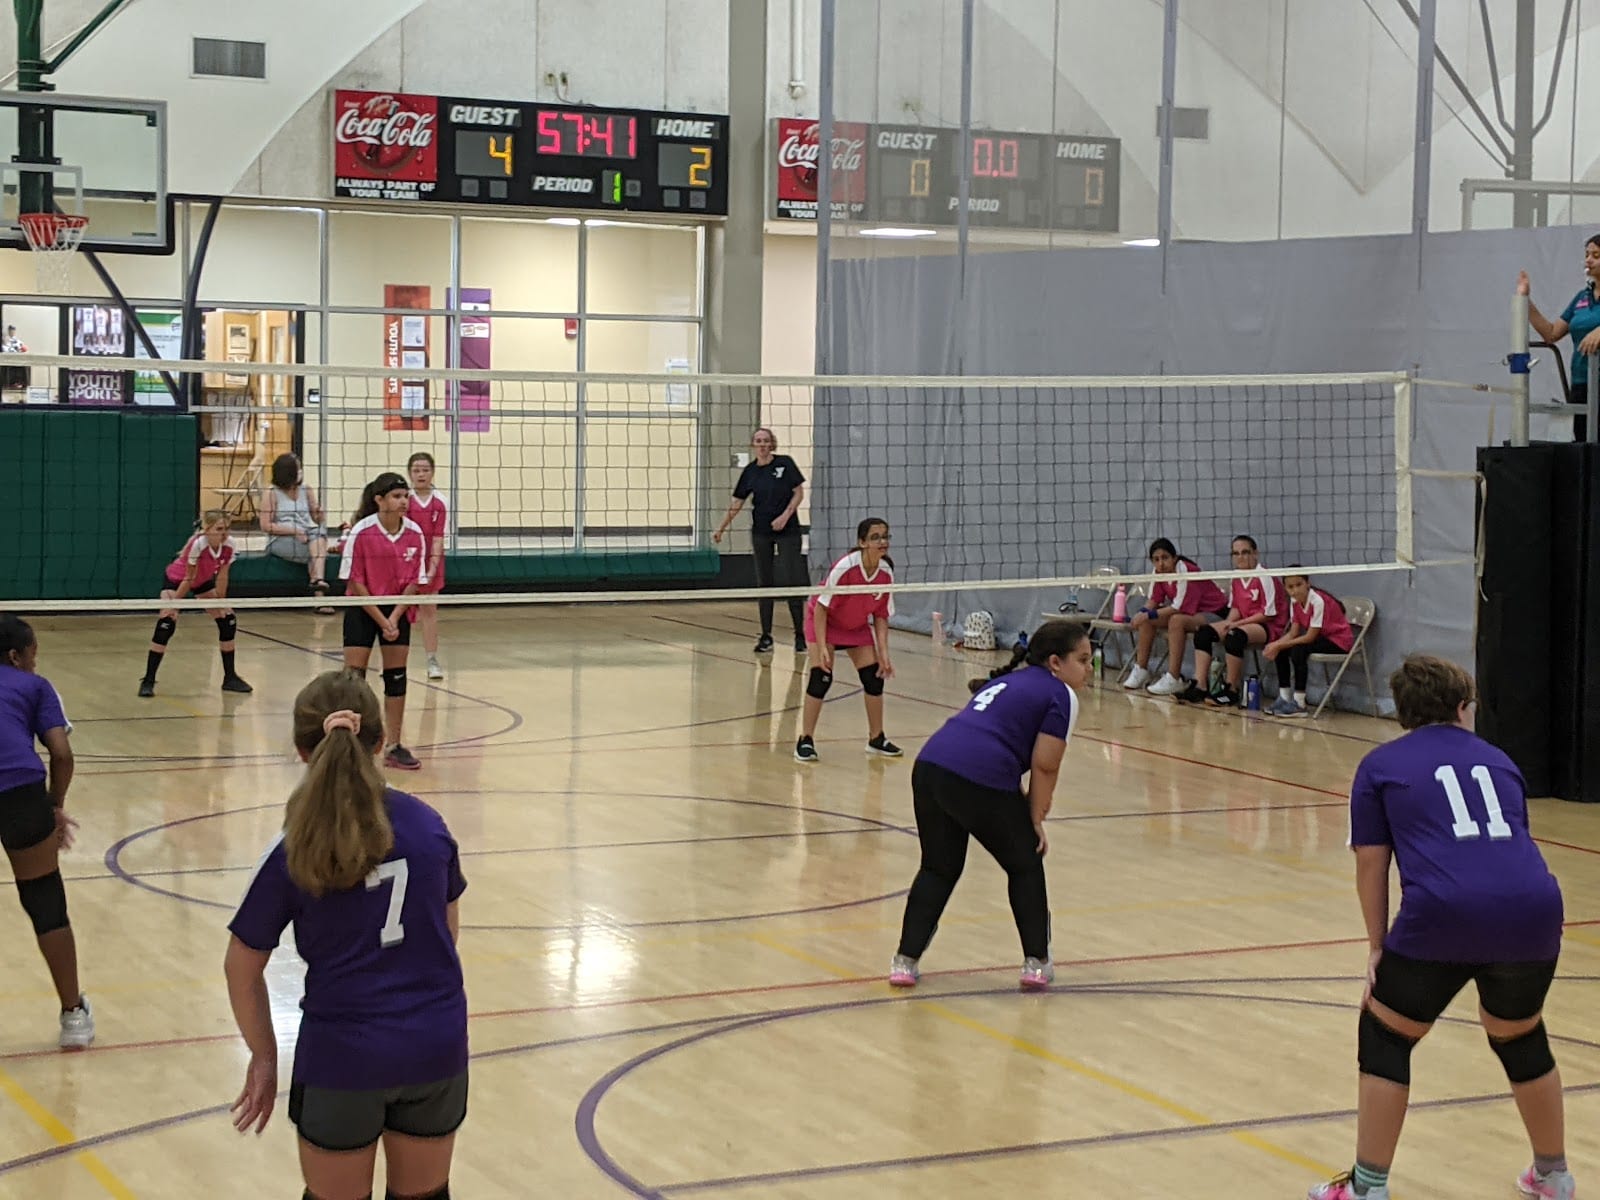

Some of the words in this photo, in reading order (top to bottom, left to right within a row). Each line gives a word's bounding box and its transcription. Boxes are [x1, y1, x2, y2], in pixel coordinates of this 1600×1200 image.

[336, 108, 436, 147] Coca-Cola
[450, 104, 520, 126] GUEST
[656, 118, 714, 138] HOME
[537, 110, 637, 159] 57:41
[877, 131, 937, 150] GUEST
[1056, 141, 1108, 160] HOME
[489, 134, 512, 176] 4
[688, 146, 712, 187] 2
[779, 136, 865, 170] Cocaola
[973, 138, 1018, 177] 0.0
[337, 178, 384, 190] ALWAYS
[386, 181, 418, 191] PART
[420, 182, 436, 192] OF
[349, 188, 380, 198] YOUR
[531, 174, 594, 195] PERIOD
[612, 171, 622, 204] 1
[910, 159, 931, 197] 0
[1085, 168, 1105, 206] 0
[948, 197, 1000, 212] PRIOD
[389, 320, 399, 355] YOUTH
[68, 386, 122, 400] SPORTS
[69, 373, 121, 390] YOUTH
[973, 682, 1008, 711] 4
[1434, 764, 1512, 841] 11
[364, 857, 409, 948] 7
